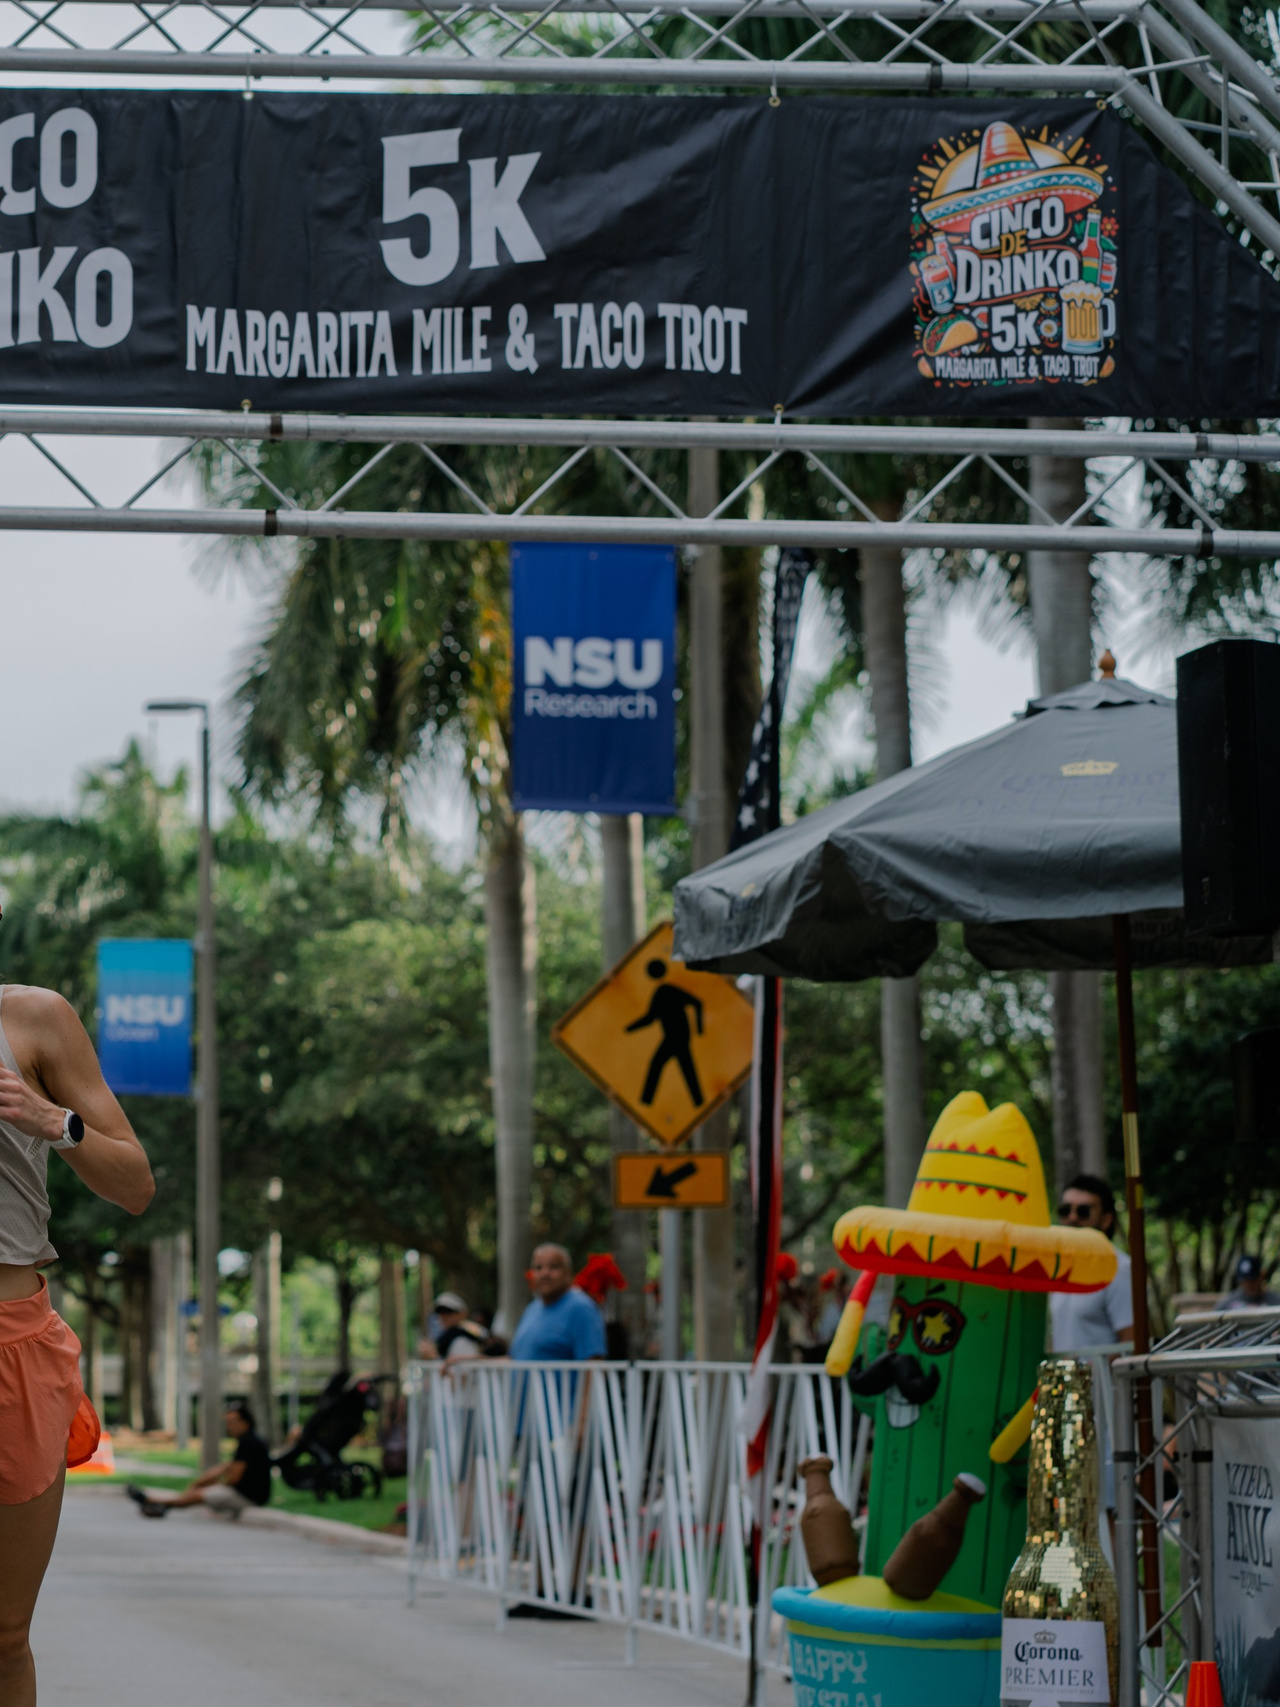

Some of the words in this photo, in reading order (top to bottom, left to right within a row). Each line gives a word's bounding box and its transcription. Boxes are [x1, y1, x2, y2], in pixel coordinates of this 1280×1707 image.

[379, 127, 547, 286] 5K
[970, 196, 1065, 249] CINCO
[1000, 229, 1028, 257] DE
[953, 249, 1079, 304] DRINKO
[185, 304, 398, 378] MARGARITA
[412, 306, 492, 375] MILE
[505, 303, 539, 374] &
[554, 302, 645, 370] TACO
[657, 302, 748, 375] TROT
[991, 304, 1041, 353] 5K
[935, 356, 998, 379] MARGARITA
[1001, 357, 1026, 378] MILE
[1028, 357, 1039, 376] &
[1042, 355, 1070, 377] TACO
[1072, 356, 1100, 378] TROT
[524, 636, 663, 690] NSU
[524, 688, 657, 719] Research
[105, 994, 186, 1027] NSU
[794, 1638, 868, 1684] HAPPY
[1015, 1640, 1080, 1665] Corona
[1005, 1667, 1095, 1687] PREMIER
